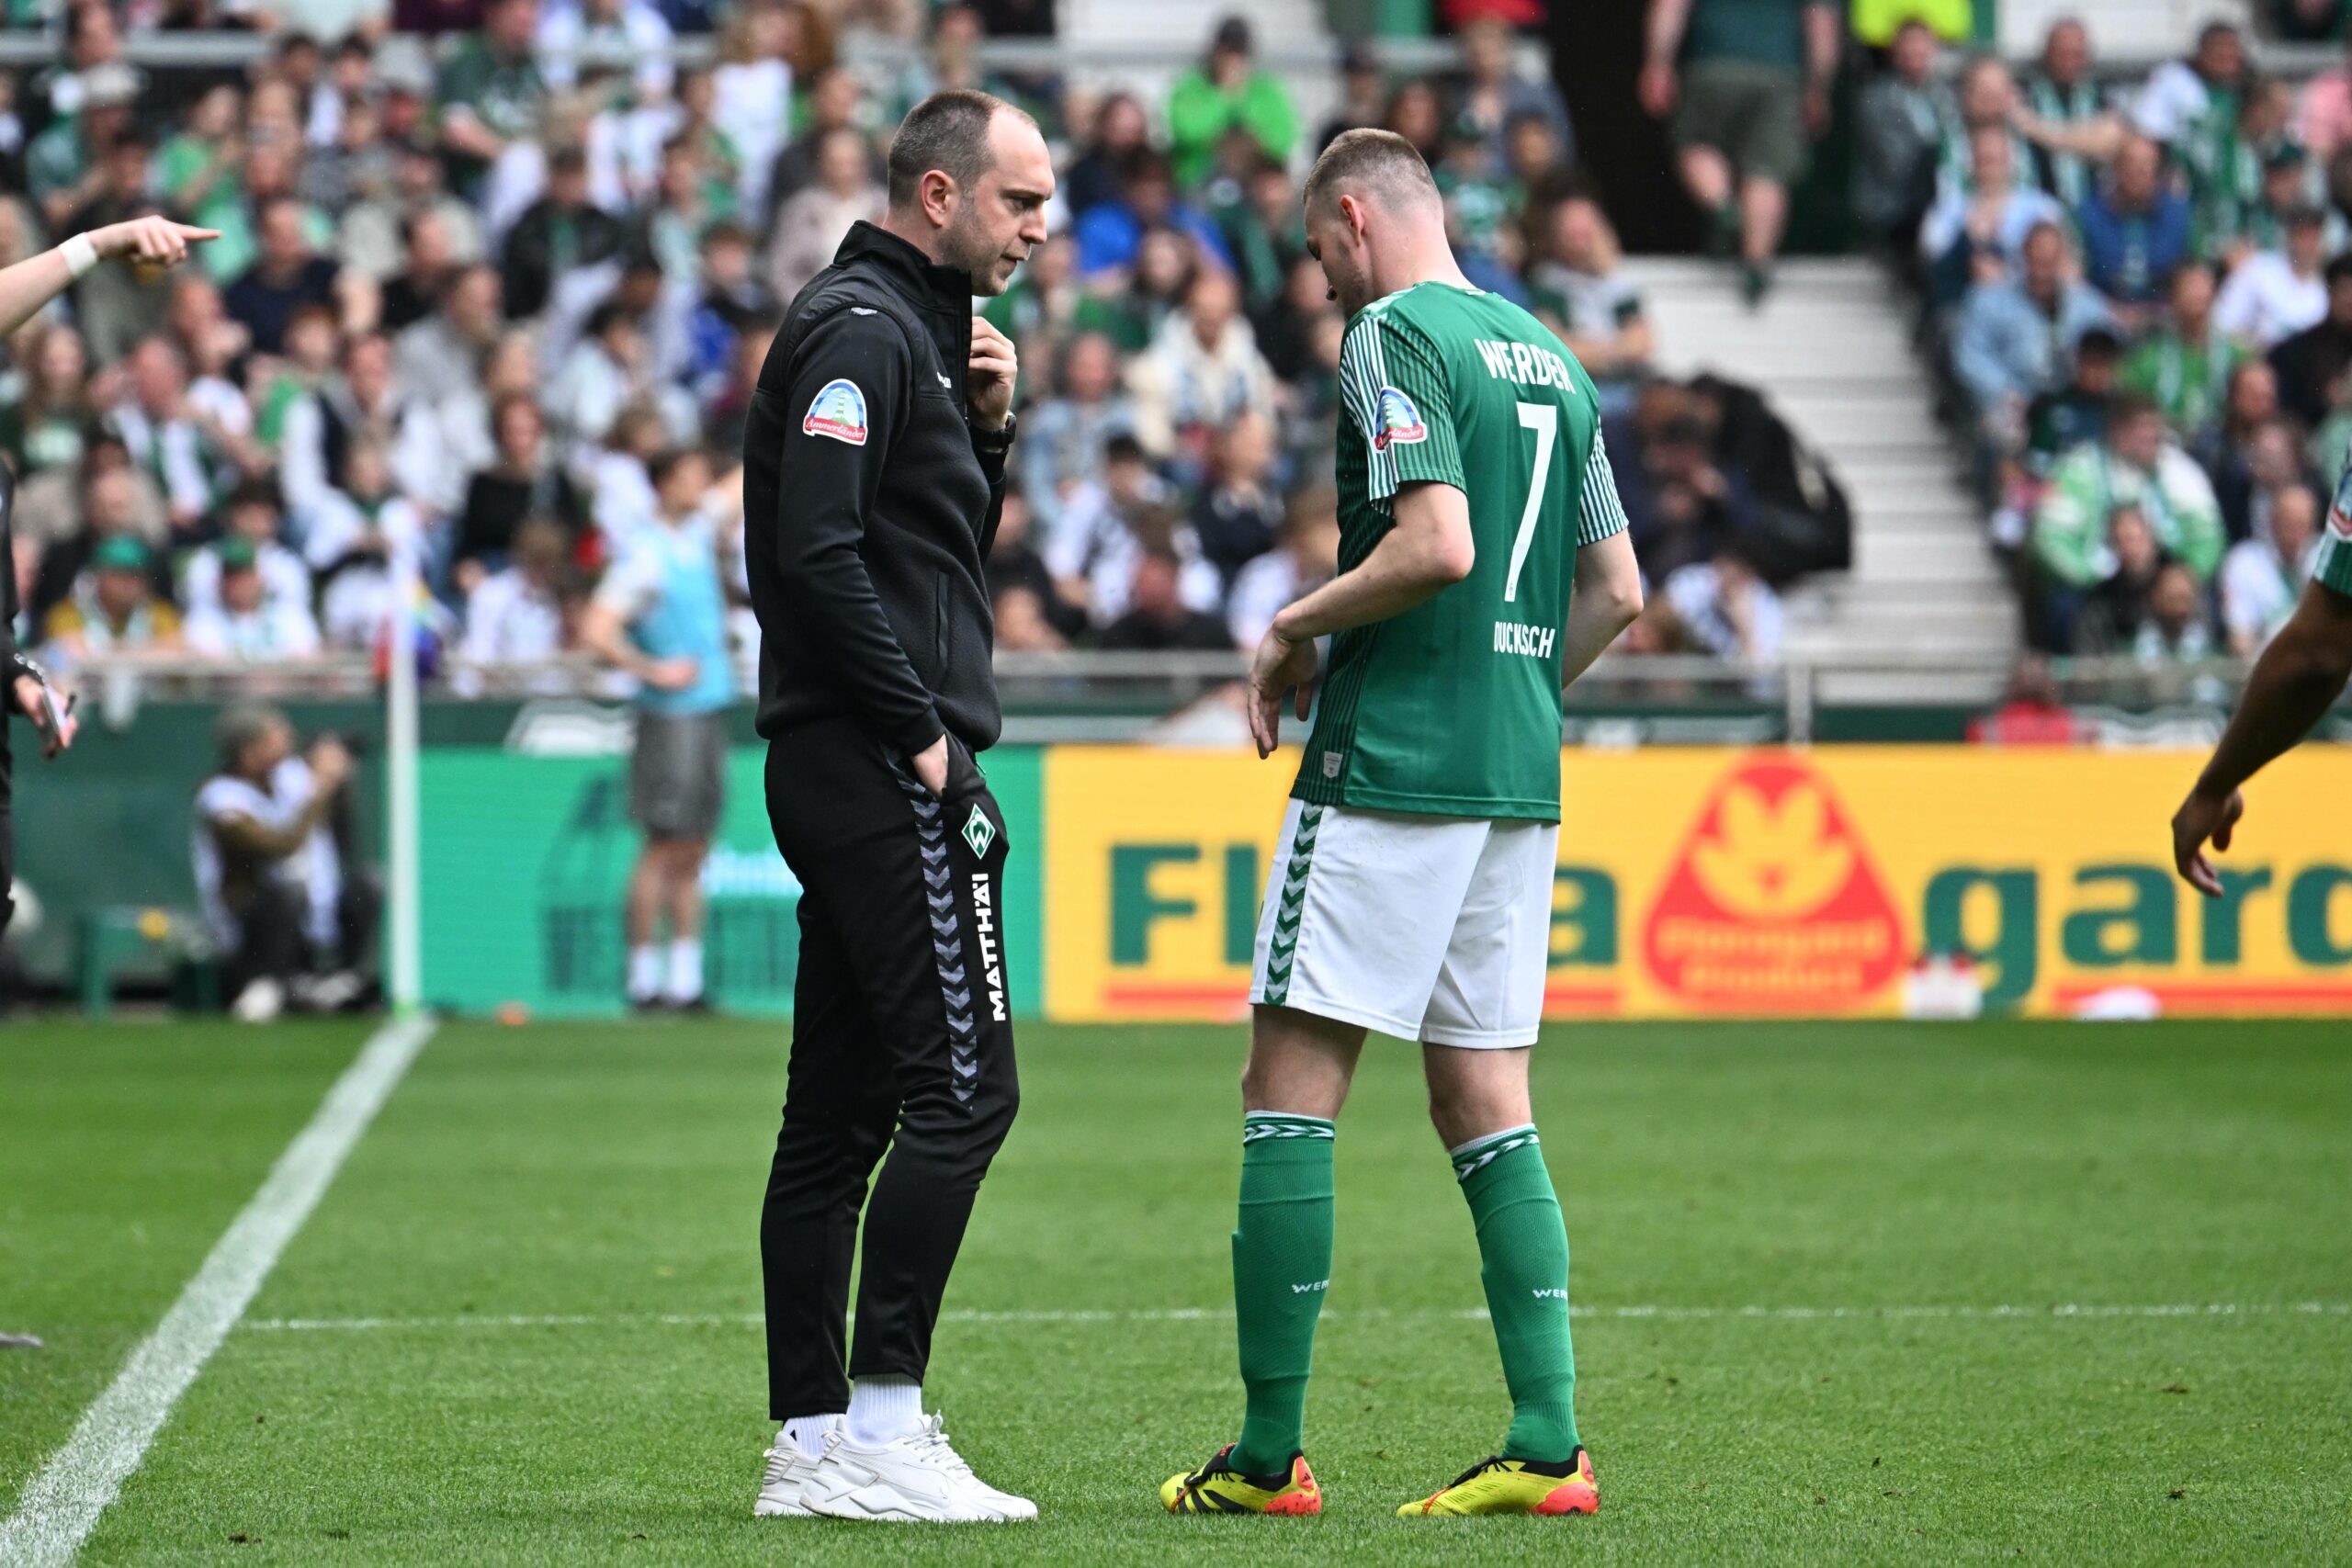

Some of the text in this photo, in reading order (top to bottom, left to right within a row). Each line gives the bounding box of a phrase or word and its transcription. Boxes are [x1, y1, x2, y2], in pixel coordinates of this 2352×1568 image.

[1474, 338, 1577, 395] WERDER
[806, 419, 865, 438] Ammerländer
[1504, 401, 1557, 603] 7
[1494, 621, 1556, 659] DUCKSCH
[972, 873, 1006, 1021] MATTHÄI
[1109, 842, 1620, 966] Fla
